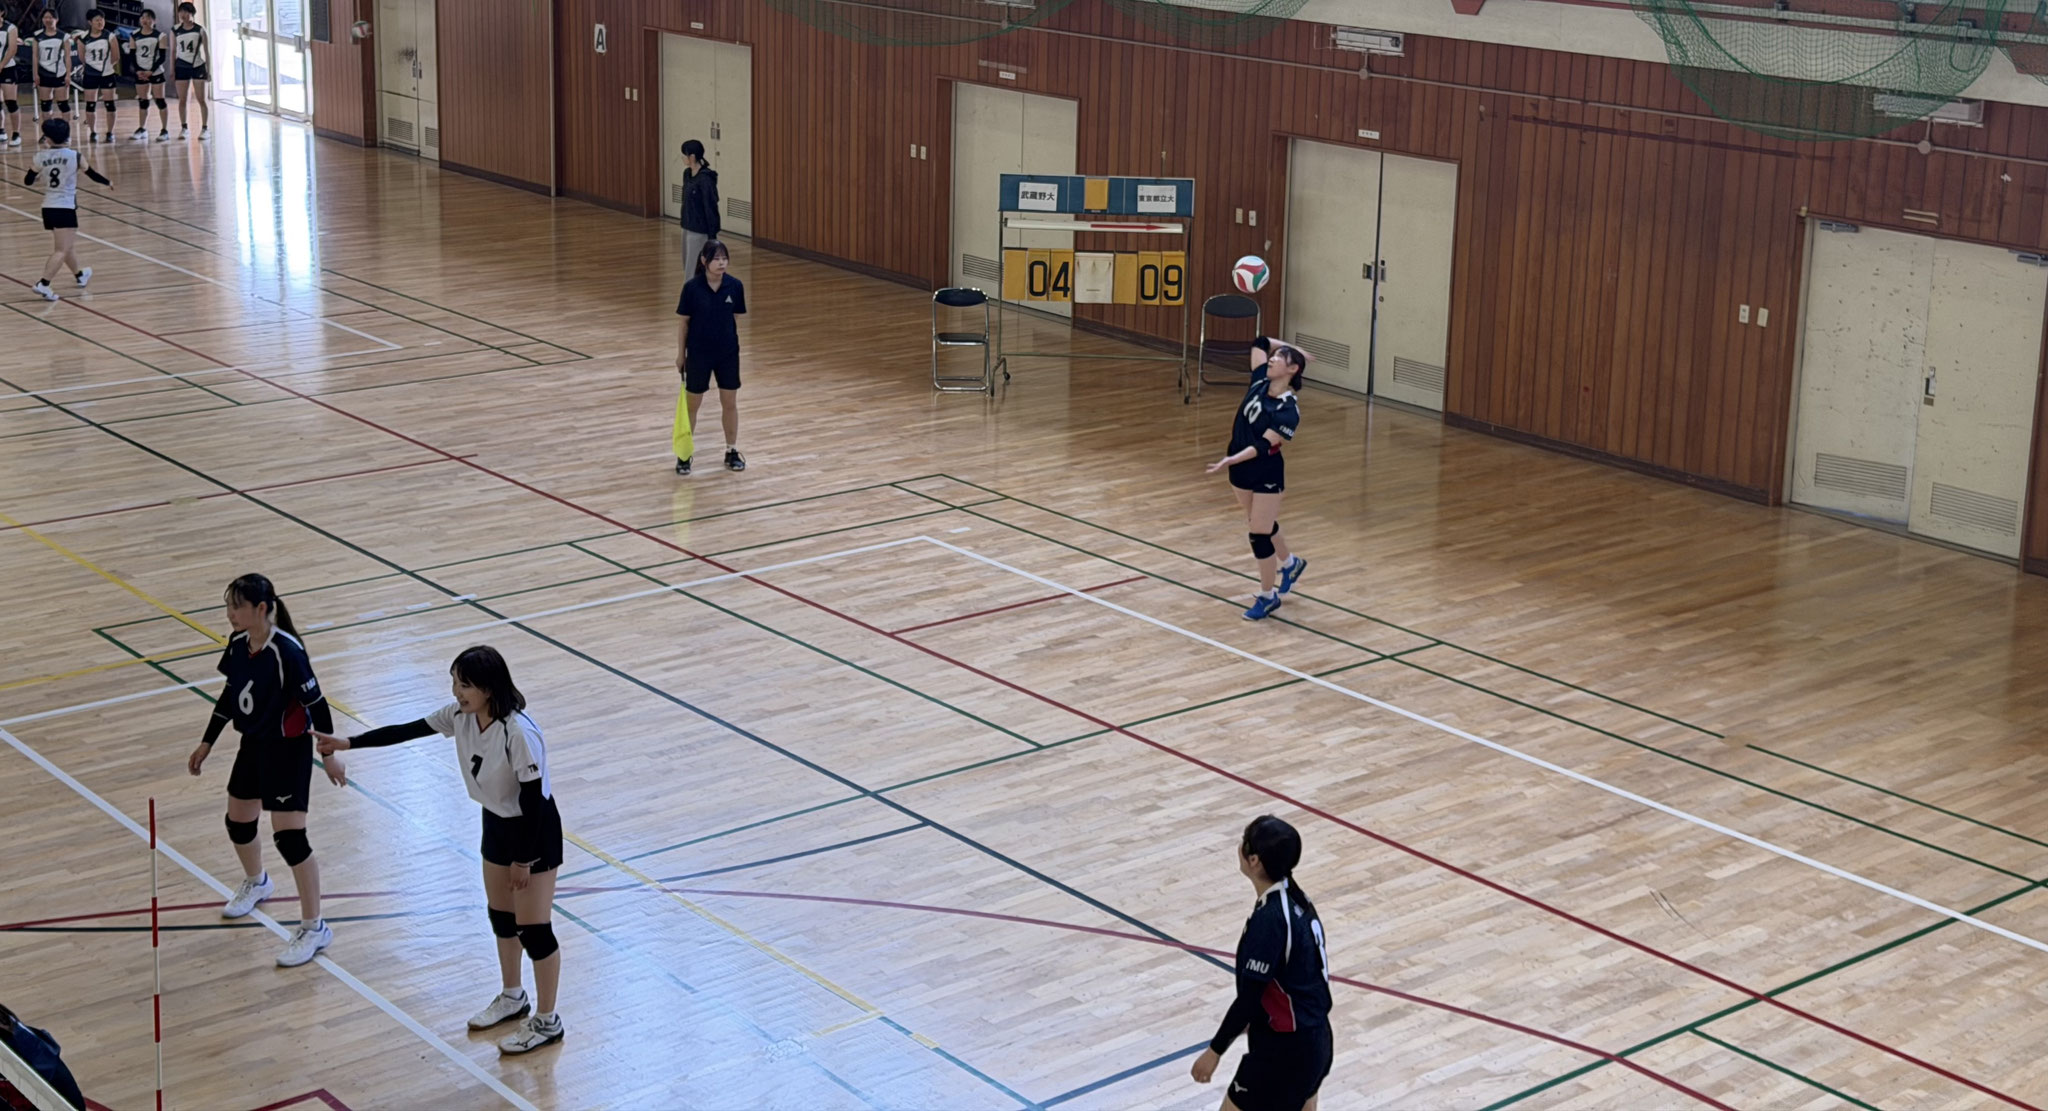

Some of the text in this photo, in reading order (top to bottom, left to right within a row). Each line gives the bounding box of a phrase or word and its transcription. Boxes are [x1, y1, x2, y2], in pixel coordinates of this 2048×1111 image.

[180, 40, 194, 53] 14
[596, 28, 605, 50] A
[46, 47, 53, 61] 7
[91, 48, 103, 61] 11
[141, 45, 149, 58] 2
[49, 167, 60, 188] 8
[1020, 190, 1056, 201] 武蔵野大
[1029, 260, 1071, 298] 04
[1140, 264, 1183, 301] 09
[238, 679, 255, 715] 6
[1245, 958, 1270, 975] TMU
